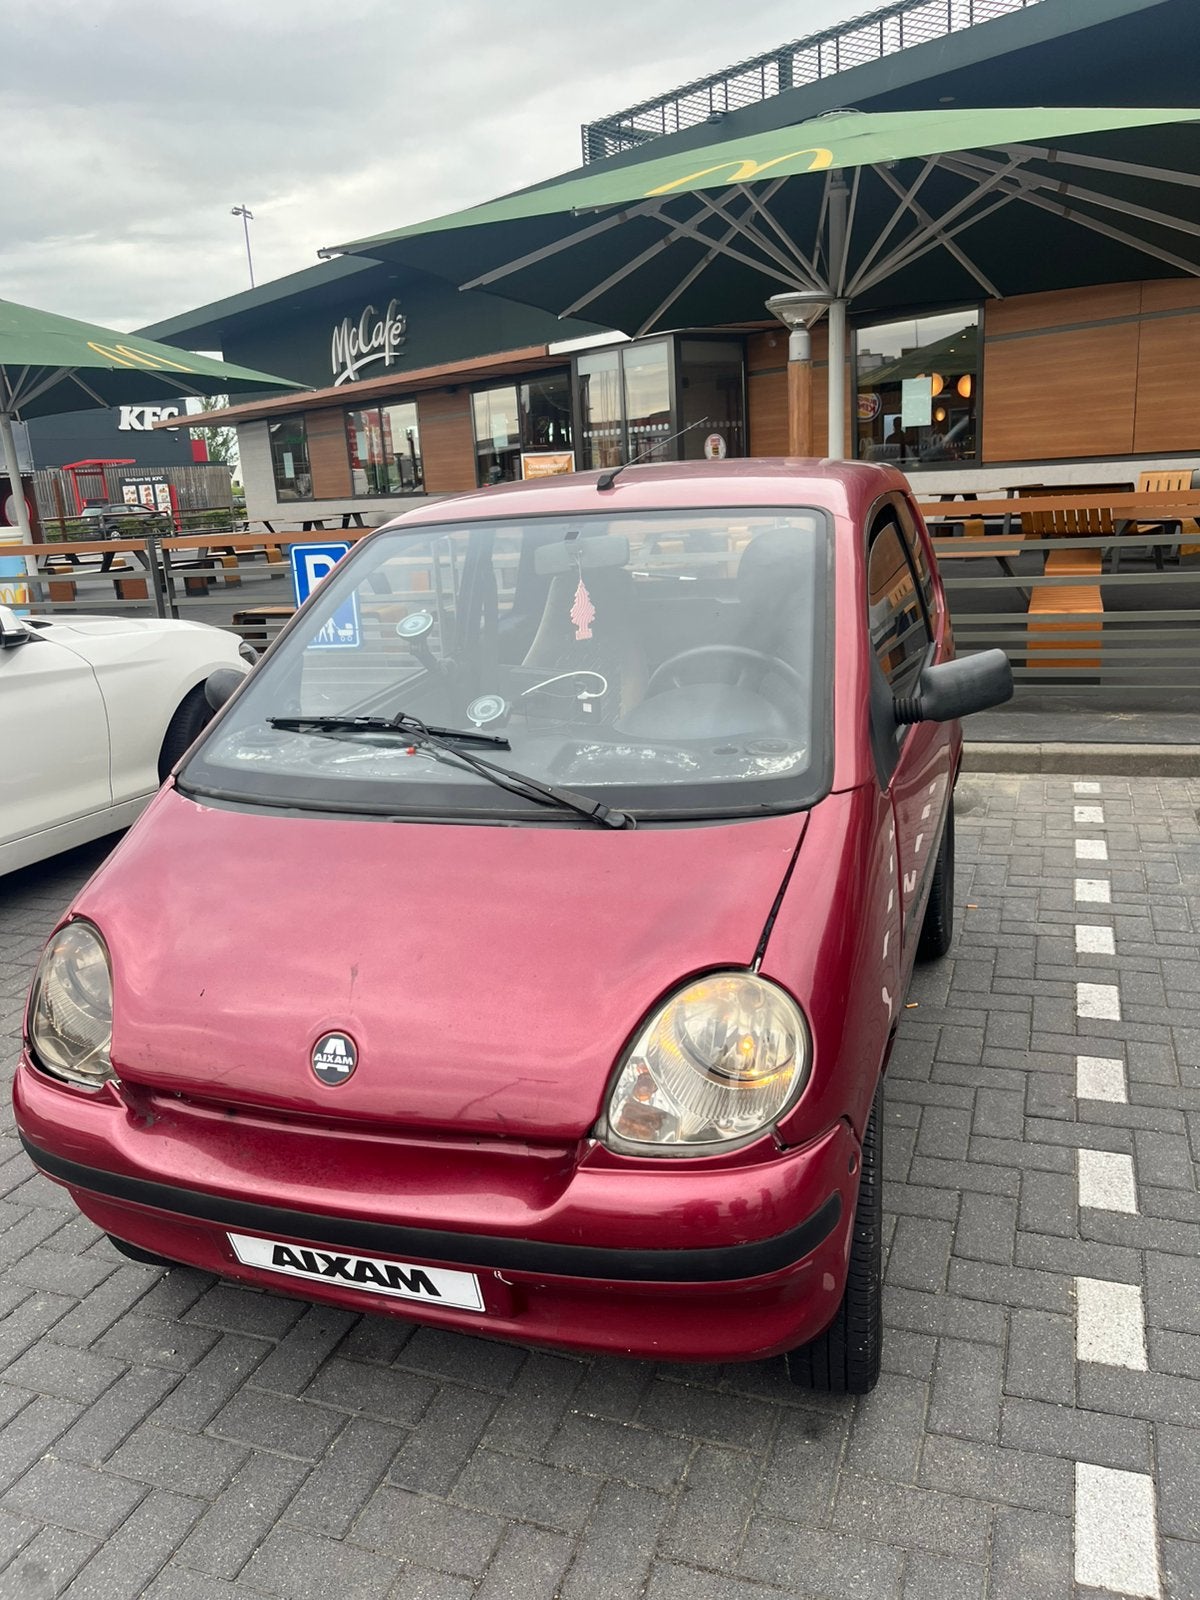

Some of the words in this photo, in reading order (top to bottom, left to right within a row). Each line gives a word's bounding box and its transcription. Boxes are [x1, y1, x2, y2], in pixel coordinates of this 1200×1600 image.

[118, 406, 180, 431] KFC
[304, 554, 337, 596] P
[313, 1053, 354, 1066] AIXAM
[272, 1244, 442, 1297] AIXAM
